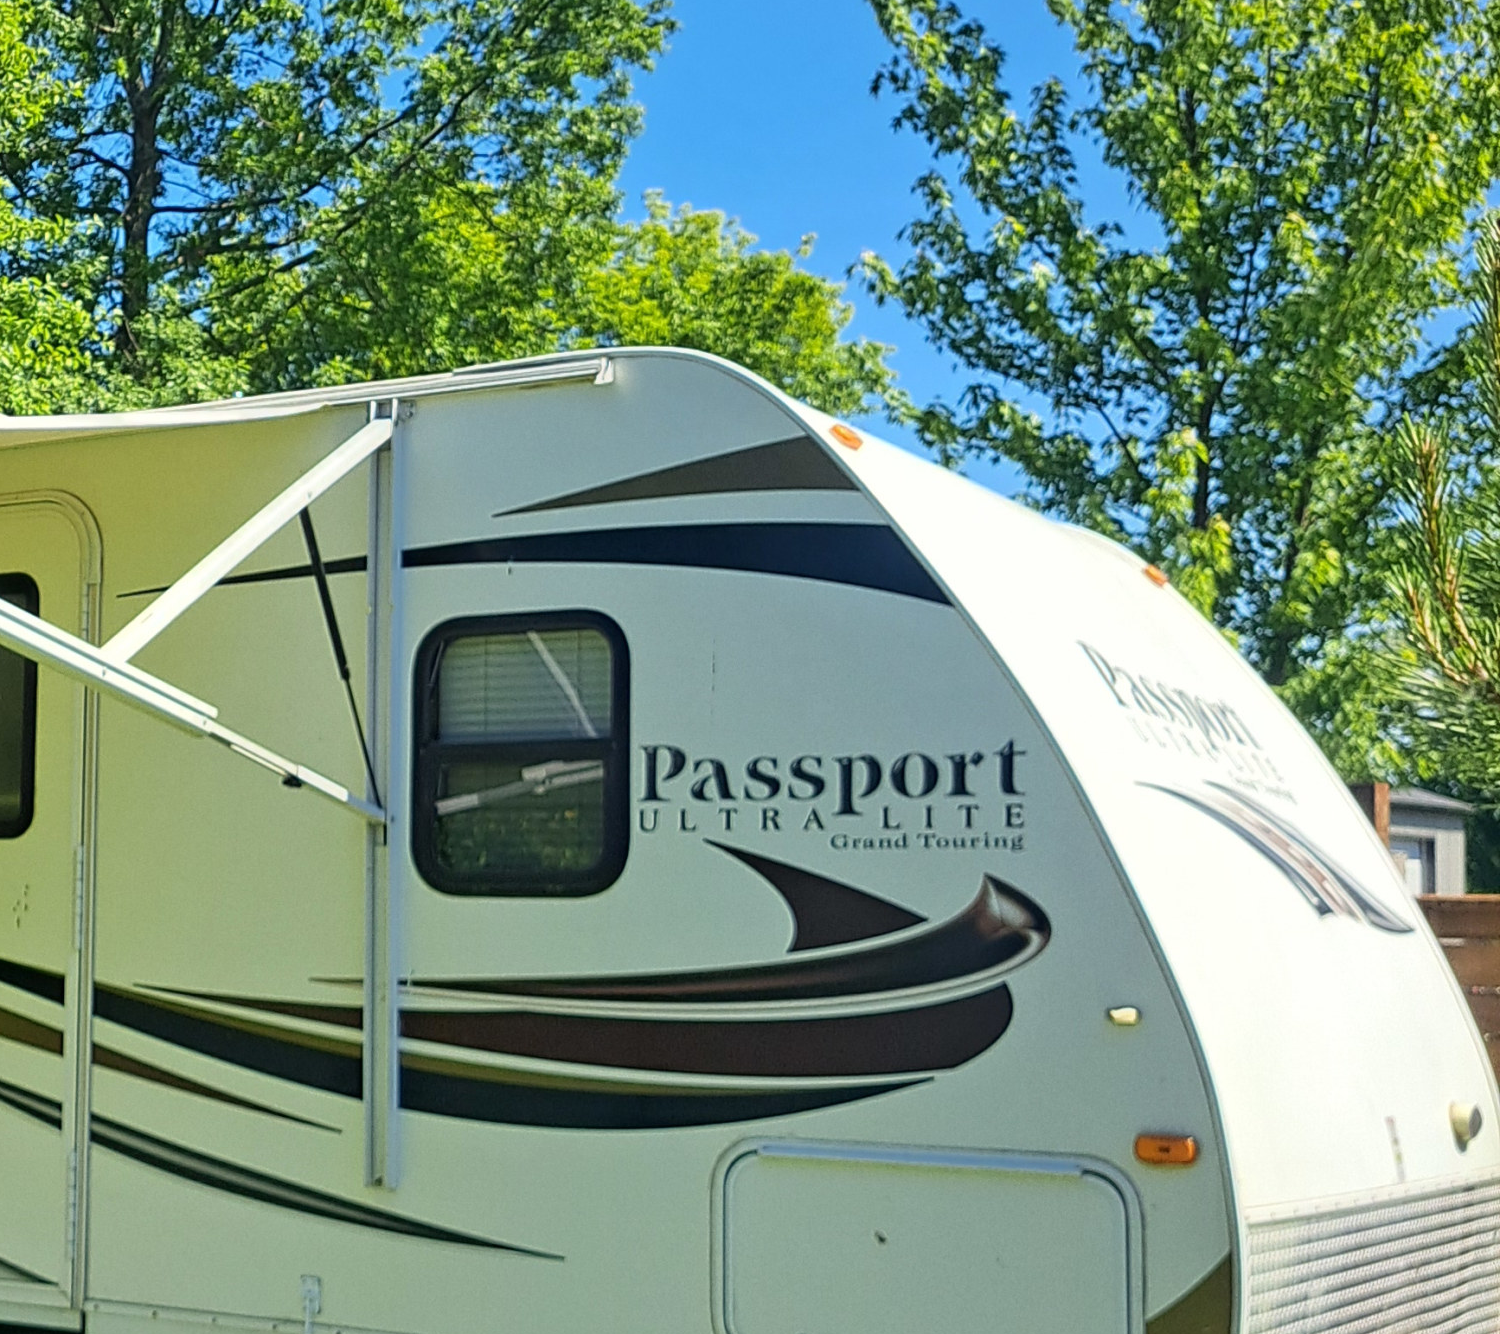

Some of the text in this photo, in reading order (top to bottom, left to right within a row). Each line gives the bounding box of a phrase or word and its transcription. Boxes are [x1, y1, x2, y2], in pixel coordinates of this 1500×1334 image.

[1076, 640, 1262, 751] Passport
[638, 738, 1028, 816] Passport
[638, 803, 1026, 833] ULTRA LITE
[829, 831, 1025, 852] Grand Touring
